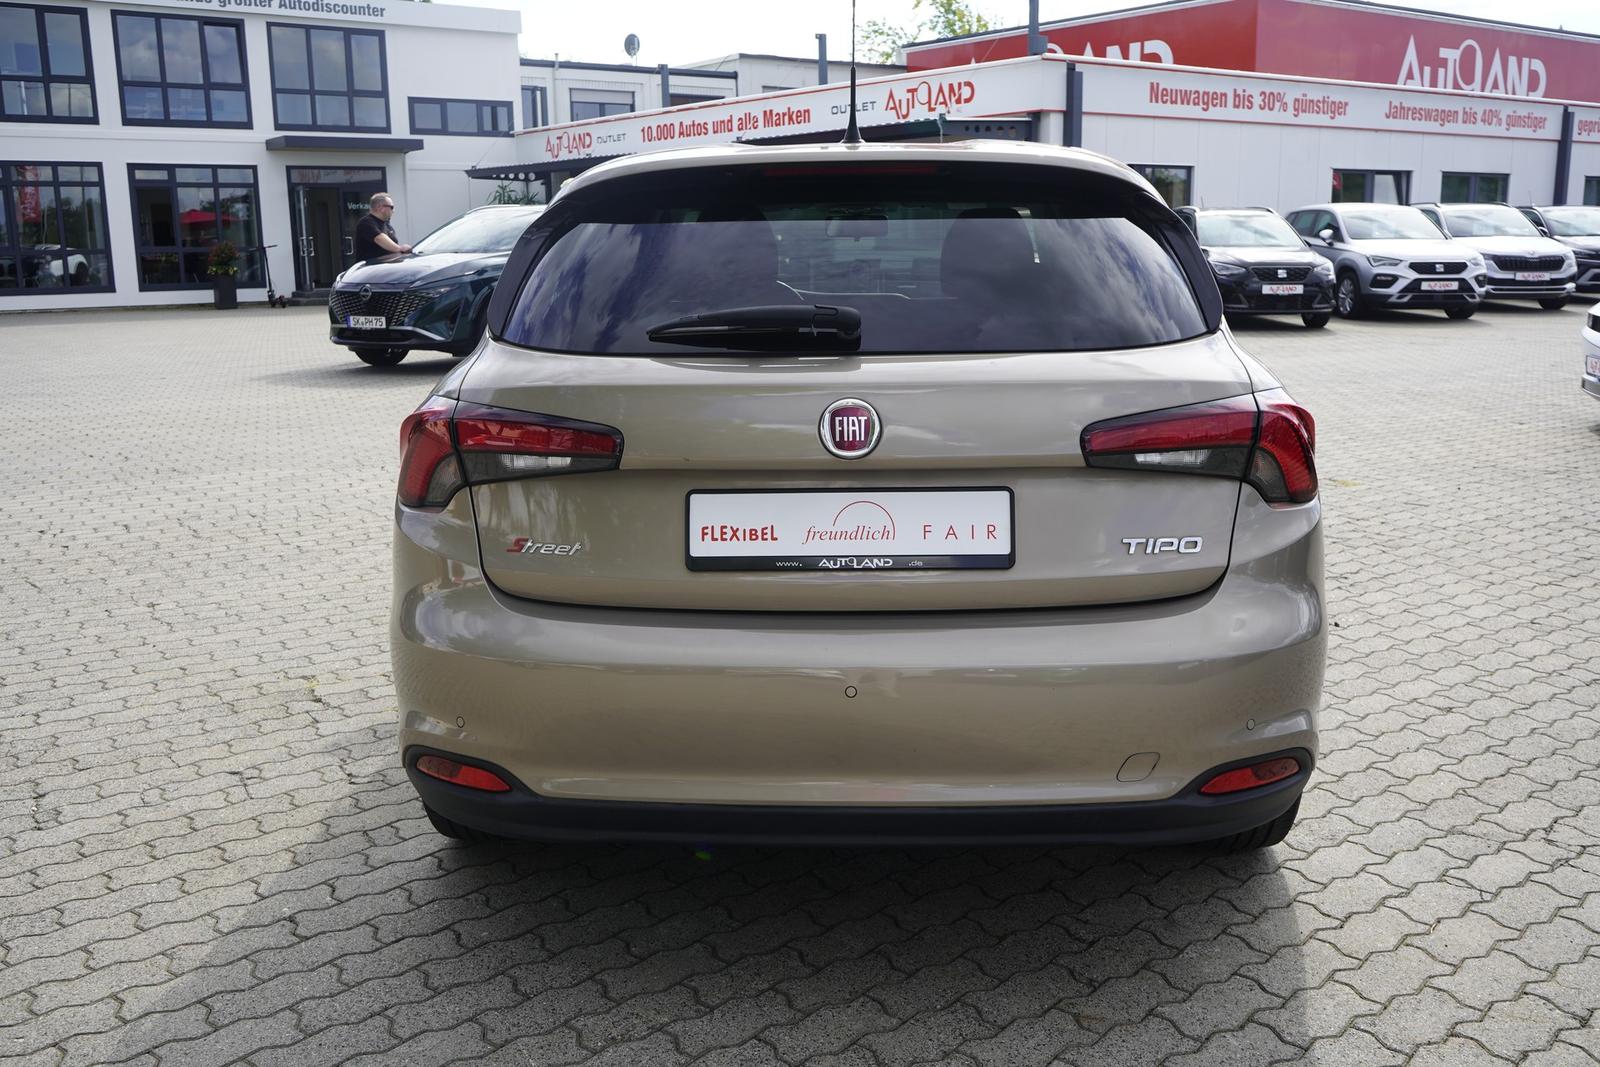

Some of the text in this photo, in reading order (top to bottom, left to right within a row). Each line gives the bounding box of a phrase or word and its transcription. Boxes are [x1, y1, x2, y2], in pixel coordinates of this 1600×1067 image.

[278, 0, 386, 17] Autodiscounter
[1149, 81, 1349, 120] Neuwagen bis 30% günstiger
[641, 106, 811, 142] 10.000 Autos und alle Marken
[1385, 100, 1548, 132] Jahreswagen bis 40% günstiger
[597, 133, 627, 144] OUTLET
[835, 416, 868, 442] FIAT
[701, 524, 998, 545] FLEXIBEL freundlich FAIR
[507, 537, 581, 556] Street
[1122, 537, 1203, 555] TIPO
[818, 556, 893, 569] AUTOLAND
